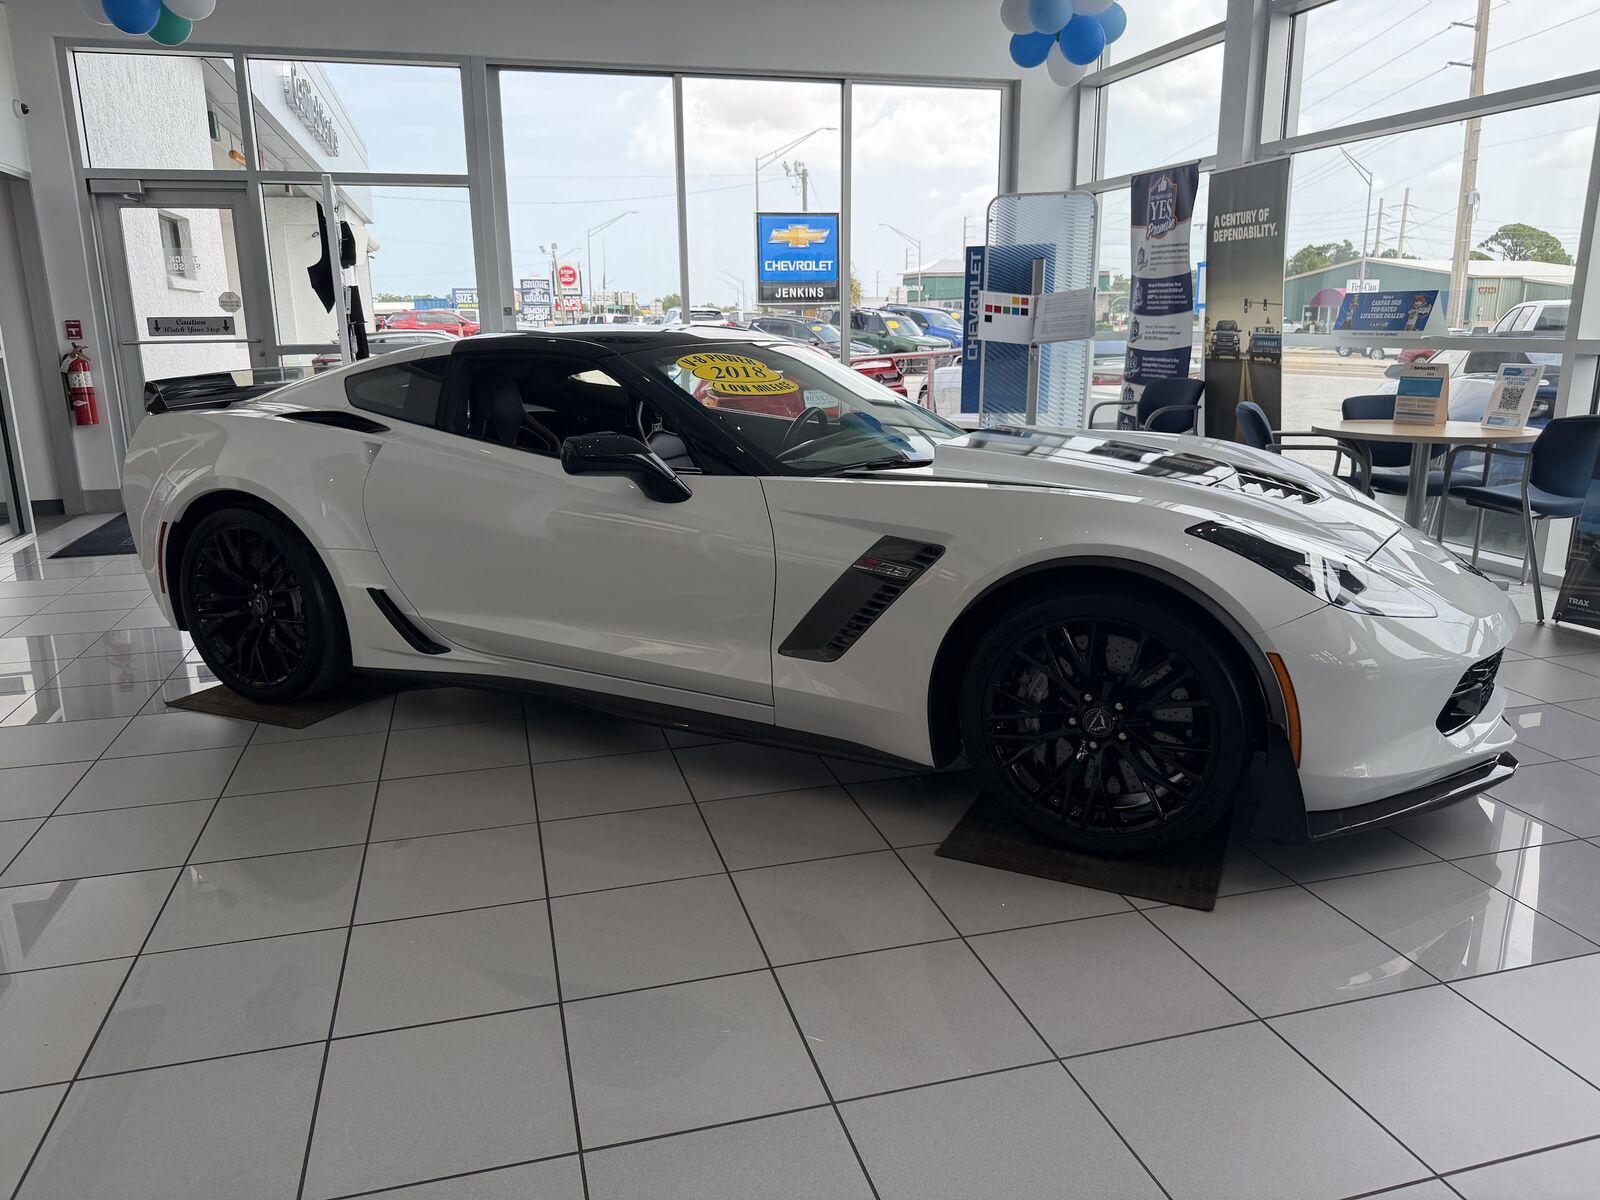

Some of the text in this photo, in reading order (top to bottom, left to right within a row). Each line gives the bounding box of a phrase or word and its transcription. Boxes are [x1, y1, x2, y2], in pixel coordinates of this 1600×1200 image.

[1151, 199, 1173, 221] YES
[1213, 207, 1270, 228] A CENTURY OF
[1146, 217, 1177, 240] Promise
[1213, 222, 1278, 243] DEPENDABILITY.
[764, 260, 834, 272] CHEVROLET
[522, 280, 550, 290] SMOKE
[456, 293, 473, 303] SIZE
[523, 294, 550, 303] WORLD
[775, 287, 824, 298] JENKINS
[966, 251, 982, 360] CHEVROLET
[681, 353, 756, 367] V-8 POWER
[710, 365, 768, 380] 2018
[720, 381, 795, 394] LOW MILEAGE
[1568, 597, 1589, 607] TRAX
